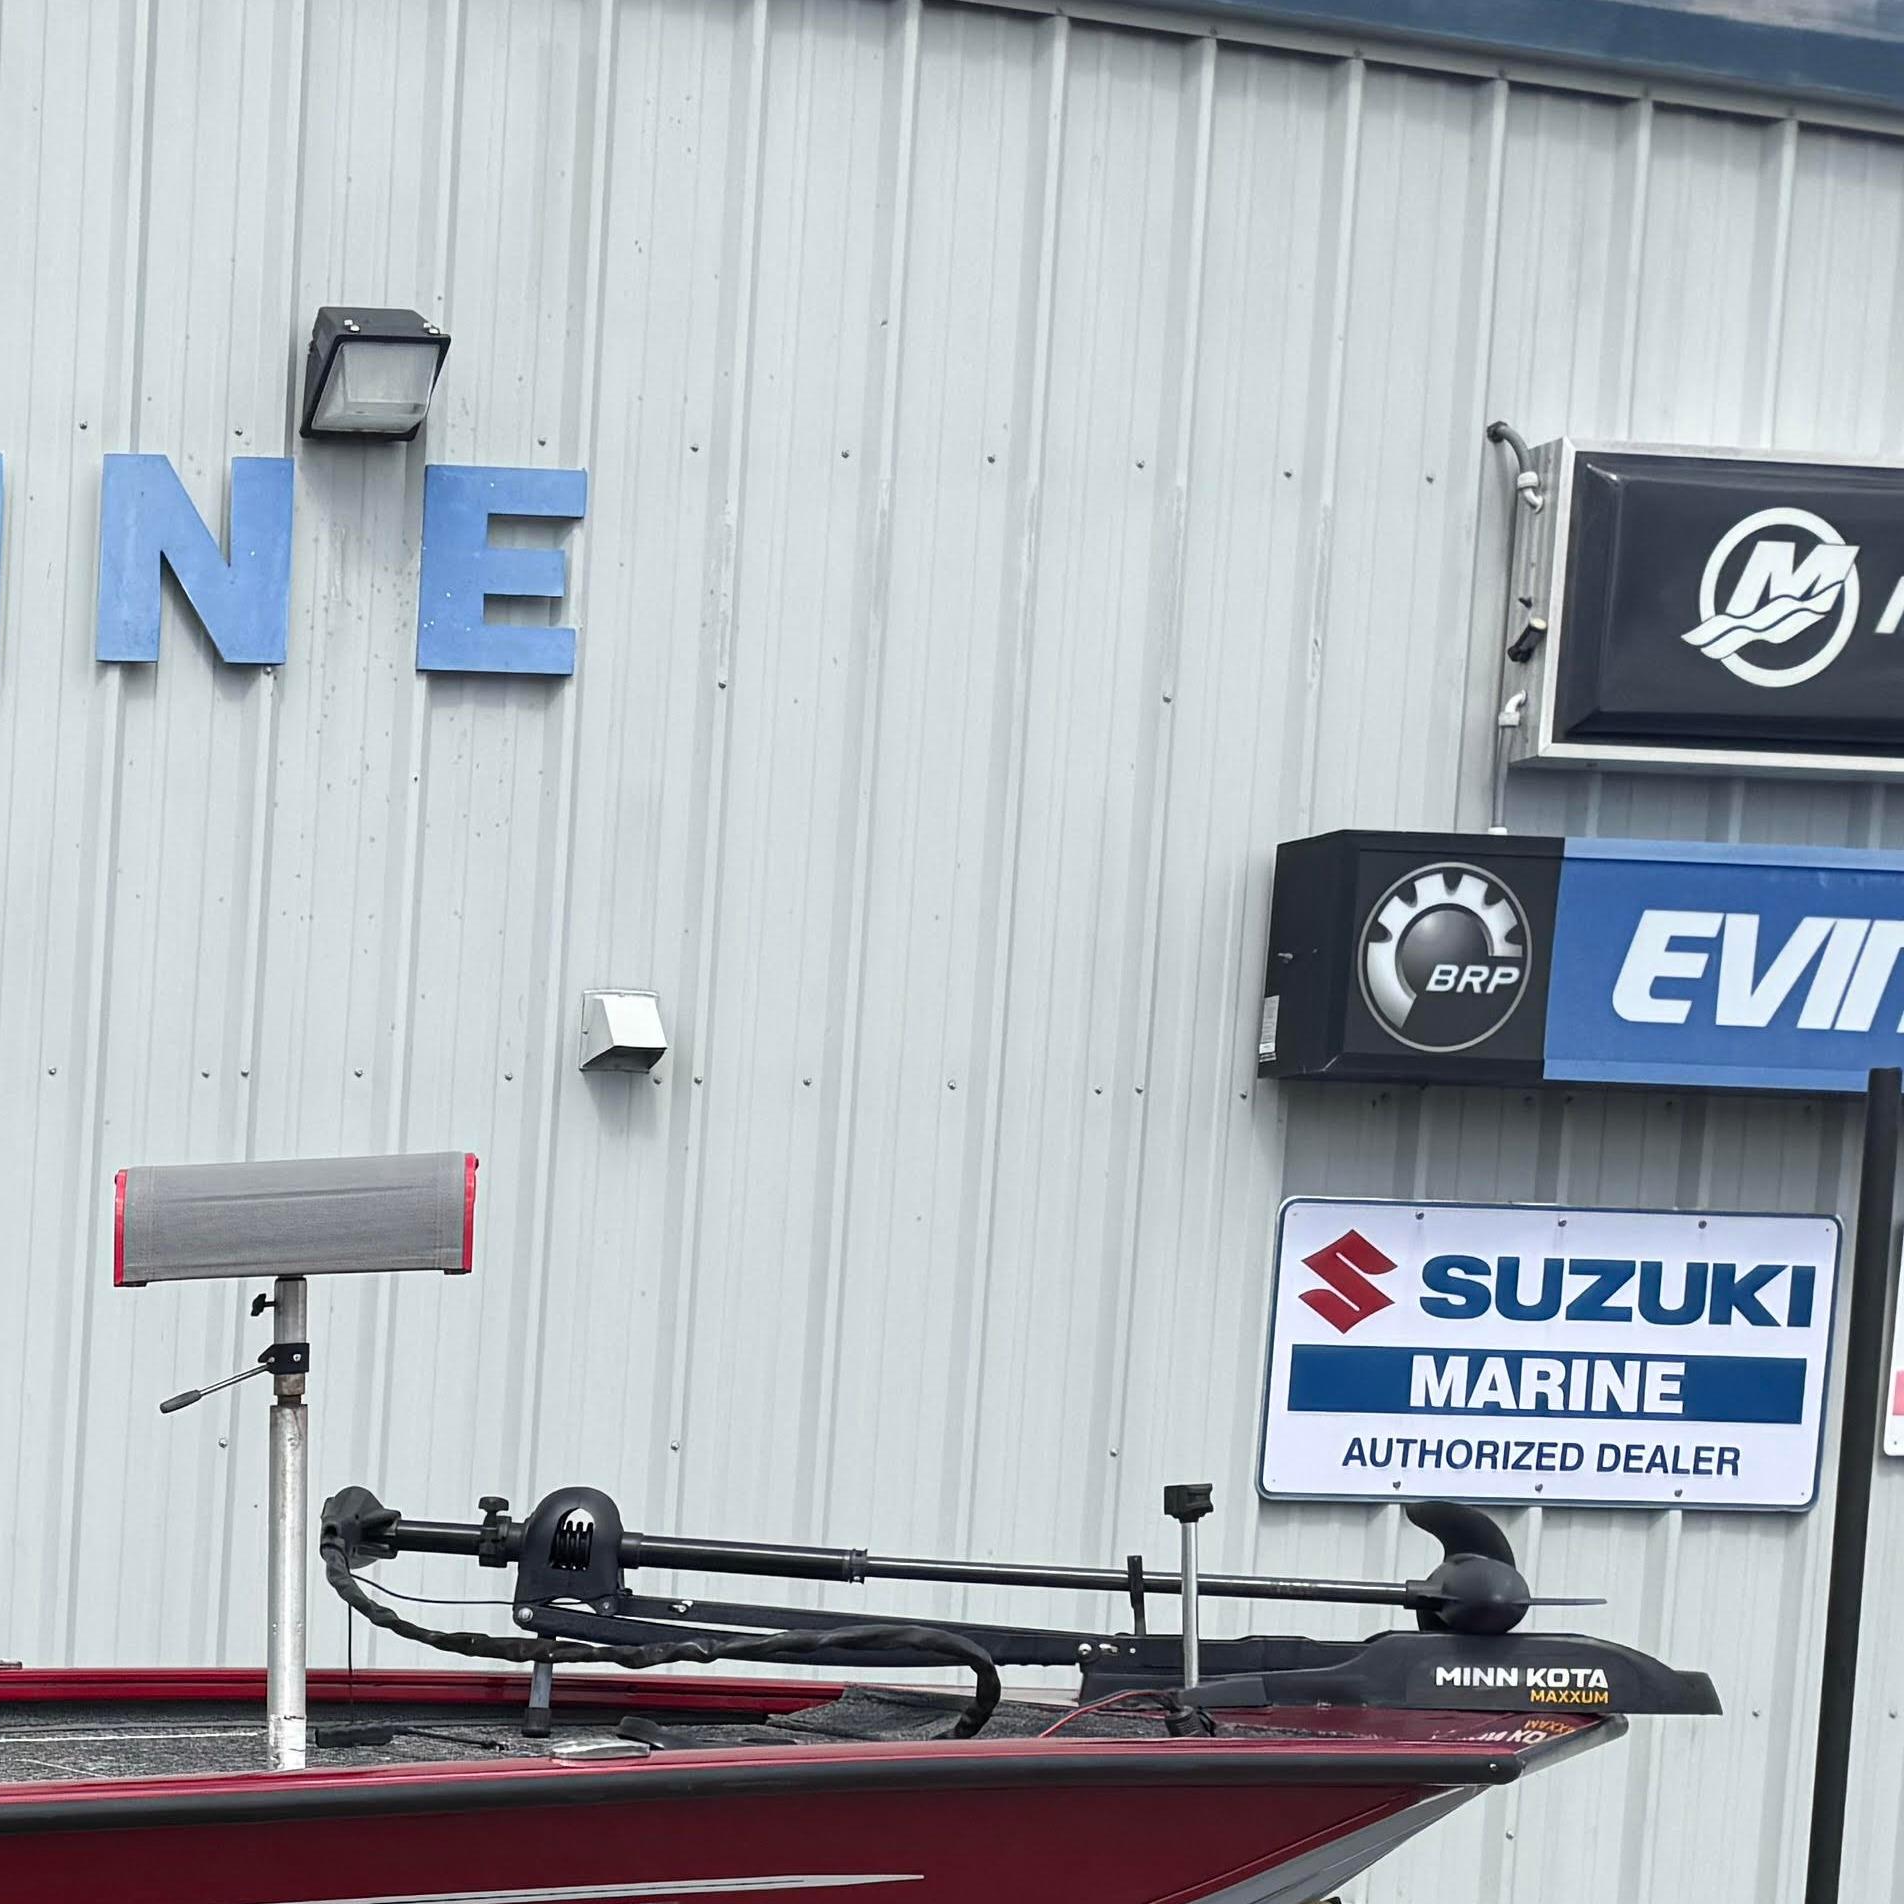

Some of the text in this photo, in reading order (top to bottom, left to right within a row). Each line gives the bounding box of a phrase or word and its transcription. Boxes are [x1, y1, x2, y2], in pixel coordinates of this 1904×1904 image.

[1425, 963, 1521, 994] BRP
[1418, 1254, 1816, 1328] SUZUKI
[1408, 1354, 1686, 1414] MARINE
[1341, 1436, 1742, 1477] AUTHORIZED DEALER
[1435, 1666, 1609, 1689] MINN KOTA
[1530, 1689, 1609, 1705] MAXXUM
